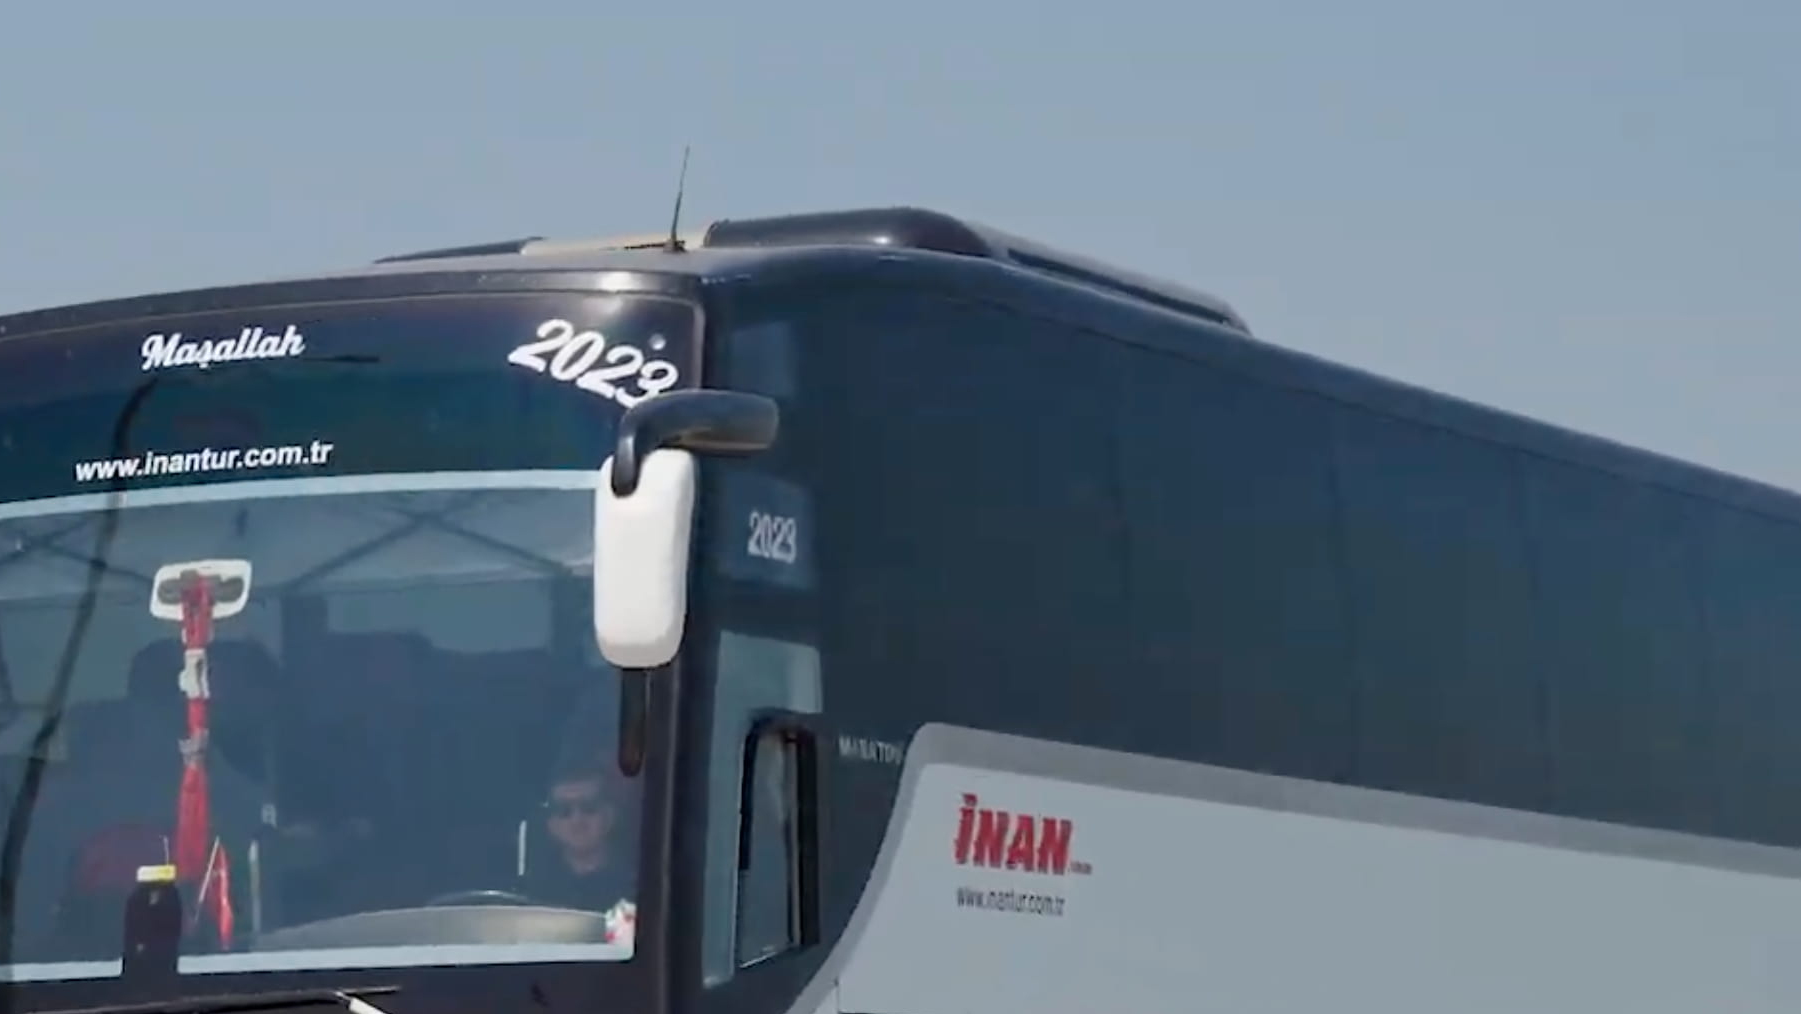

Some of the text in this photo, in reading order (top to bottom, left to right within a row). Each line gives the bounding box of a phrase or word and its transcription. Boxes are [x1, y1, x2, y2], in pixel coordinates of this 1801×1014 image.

[140, 324, 306, 371] Maşallah
[507, 318, 679, 409] 2023
[75, 440, 334, 482] www.inantur.com.tr
[748, 510, 797, 564] 2023
